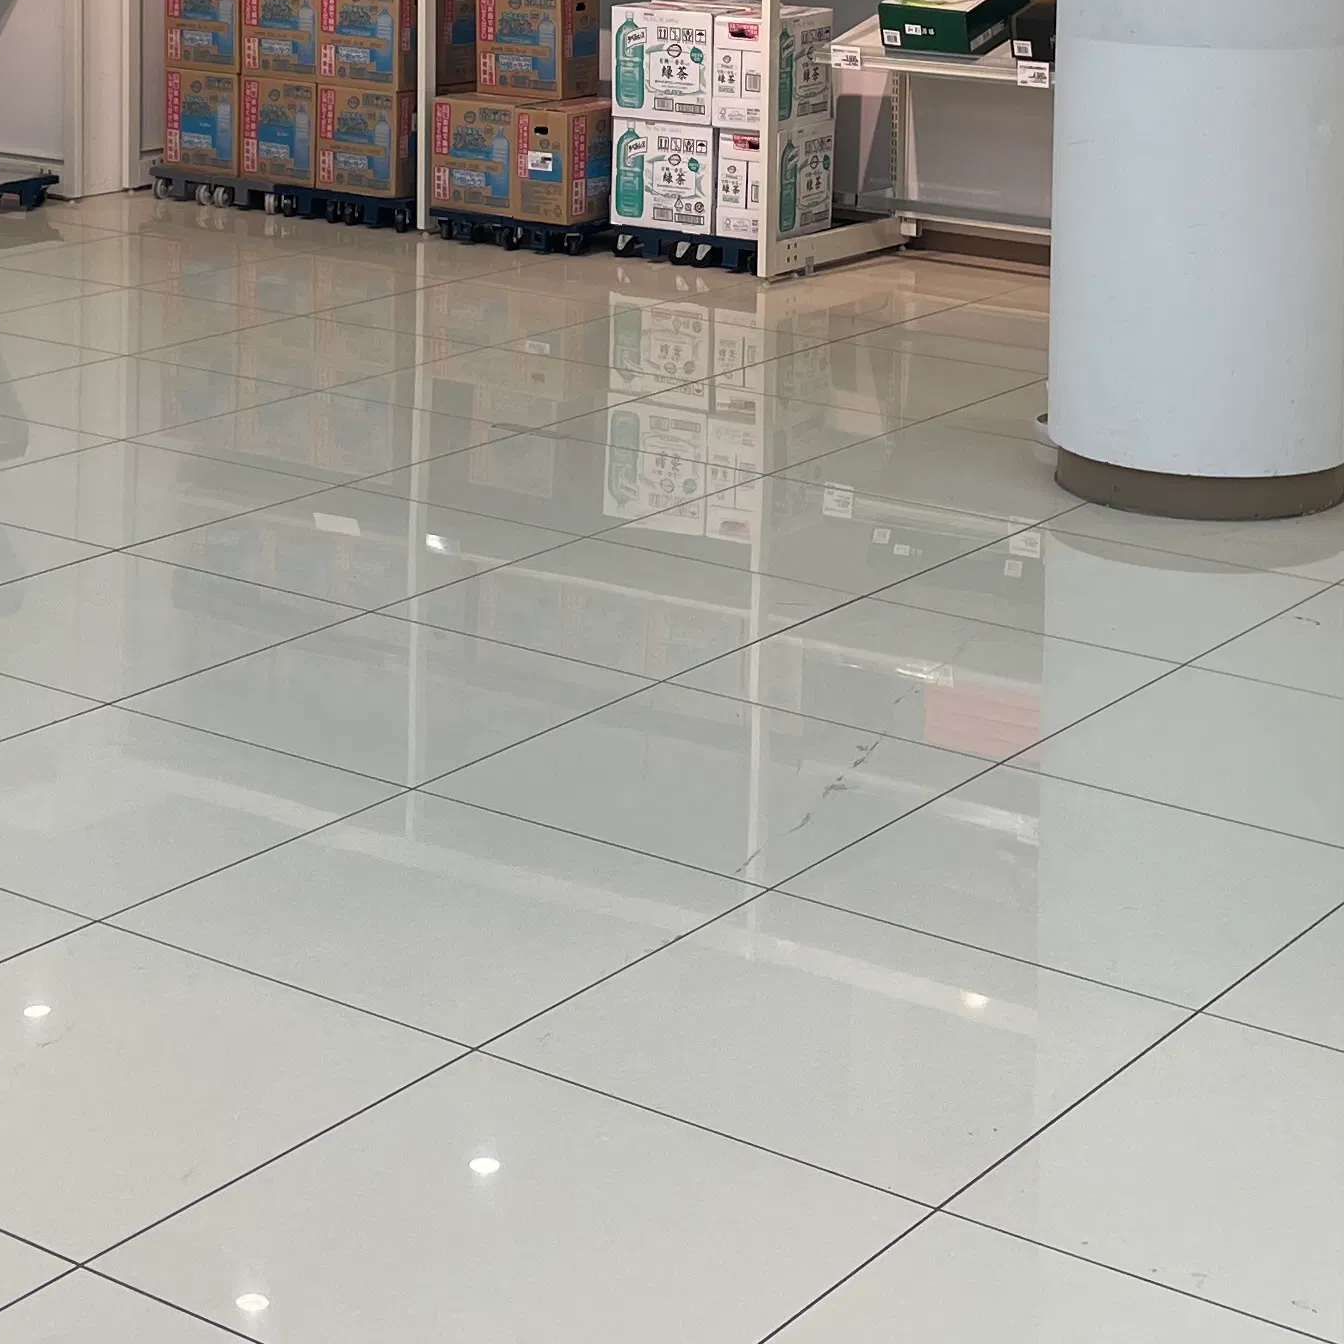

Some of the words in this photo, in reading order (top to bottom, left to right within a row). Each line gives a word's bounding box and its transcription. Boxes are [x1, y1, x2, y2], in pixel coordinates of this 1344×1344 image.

[661, 65, 689, 80] 緑茶
[717, 73, 736, 85] 緑茶
[662, 173, 687, 186] 緑茶
[721, 183, 741, 194] 緑茶
